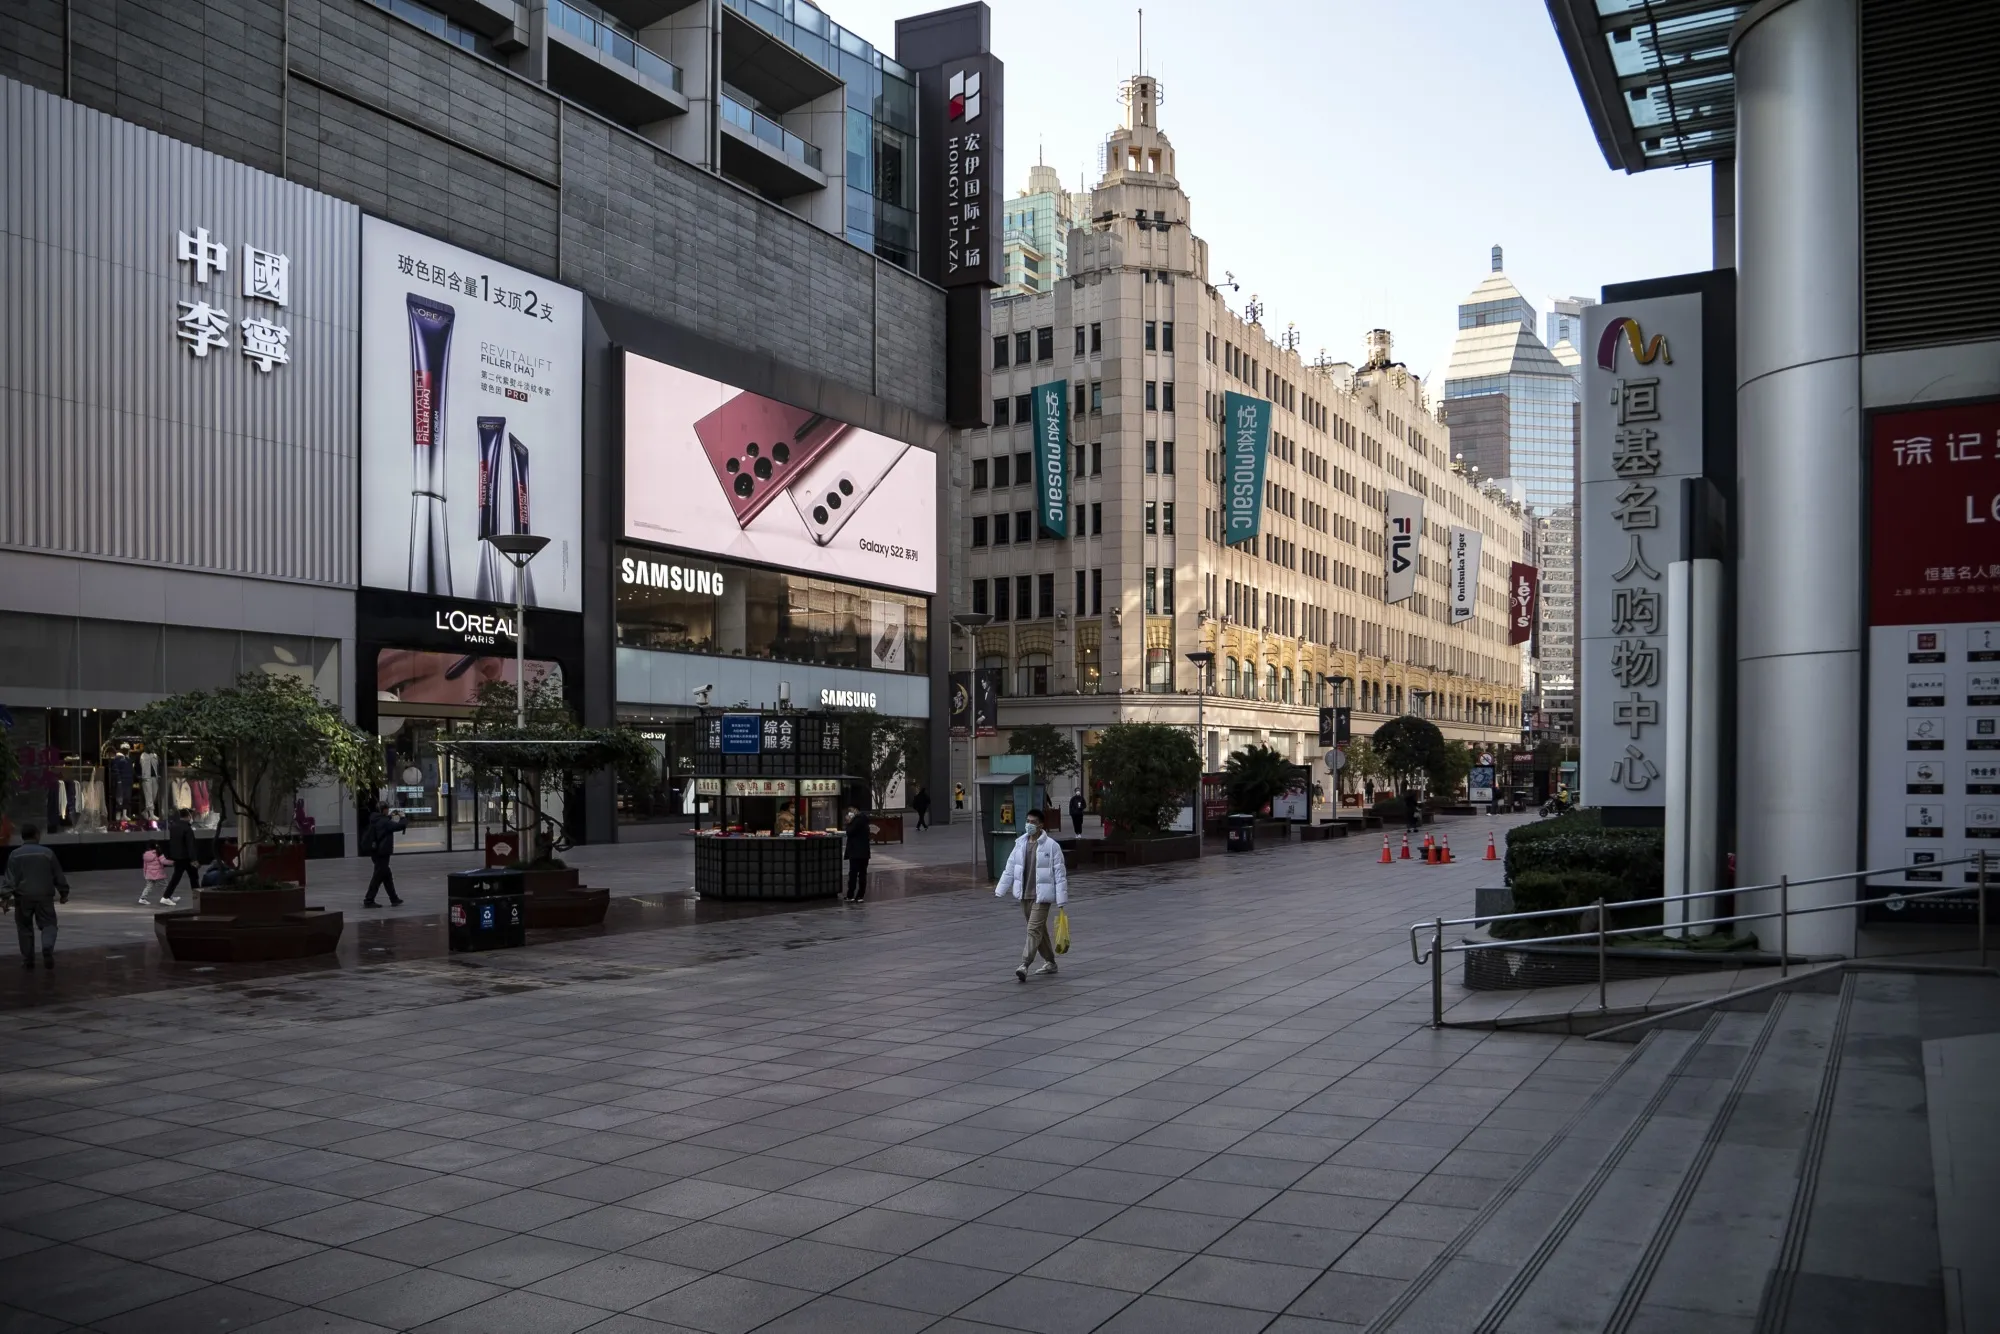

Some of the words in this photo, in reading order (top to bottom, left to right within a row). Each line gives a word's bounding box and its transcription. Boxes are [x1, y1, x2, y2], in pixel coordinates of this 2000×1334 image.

[949, 137, 959, 207] HONGYI
[964, 133, 981, 267] 宏伊国际广场
[949, 216, 959, 273] PLAZA
[177, 227, 290, 306] 中國
[397, 253, 554, 323] 玻色因含量1支顶2支
[177, 301, 291, 372] 李寧
[480, 341, 553, 371] REVITALIFT
[480, 354, 512, 370] FILLER
[513, 363, 535, 378] [HA]
[416, 373, 424, 442] REVITALIFT
[480, 382, 502, 396] 玻色因
[506, 389, 527, 401] PRO
[1892, 430, 2000, 466] 徐记
[859, 538, 889, 558] Galaxy
[890, 545, 904, 559] S22
[905, 549, 919, 561] 系列
[1392, 517, 1412, 574] FILA
[1457, 533, 1467, 559] Tiger
[621, 557, 724, 596] SAMSUNG
[1457, 559, 1466, 602] Onitsuka
[1610, 377, 1660, 791] 恒基名人购物中心
[1517, 575, 1531, 628] Levi's
[436, 611, 519, 637] L'ORÉAL
[464, 634, 495, 645] PARIS
[821, 688, 877, 708] SAMSUNG
[764, 720, 793, 734] 综合
[764, 735, 793, 749] 服务
[822, 737, 840, 749] 经典
[823, 722, 840, 736] 上海
